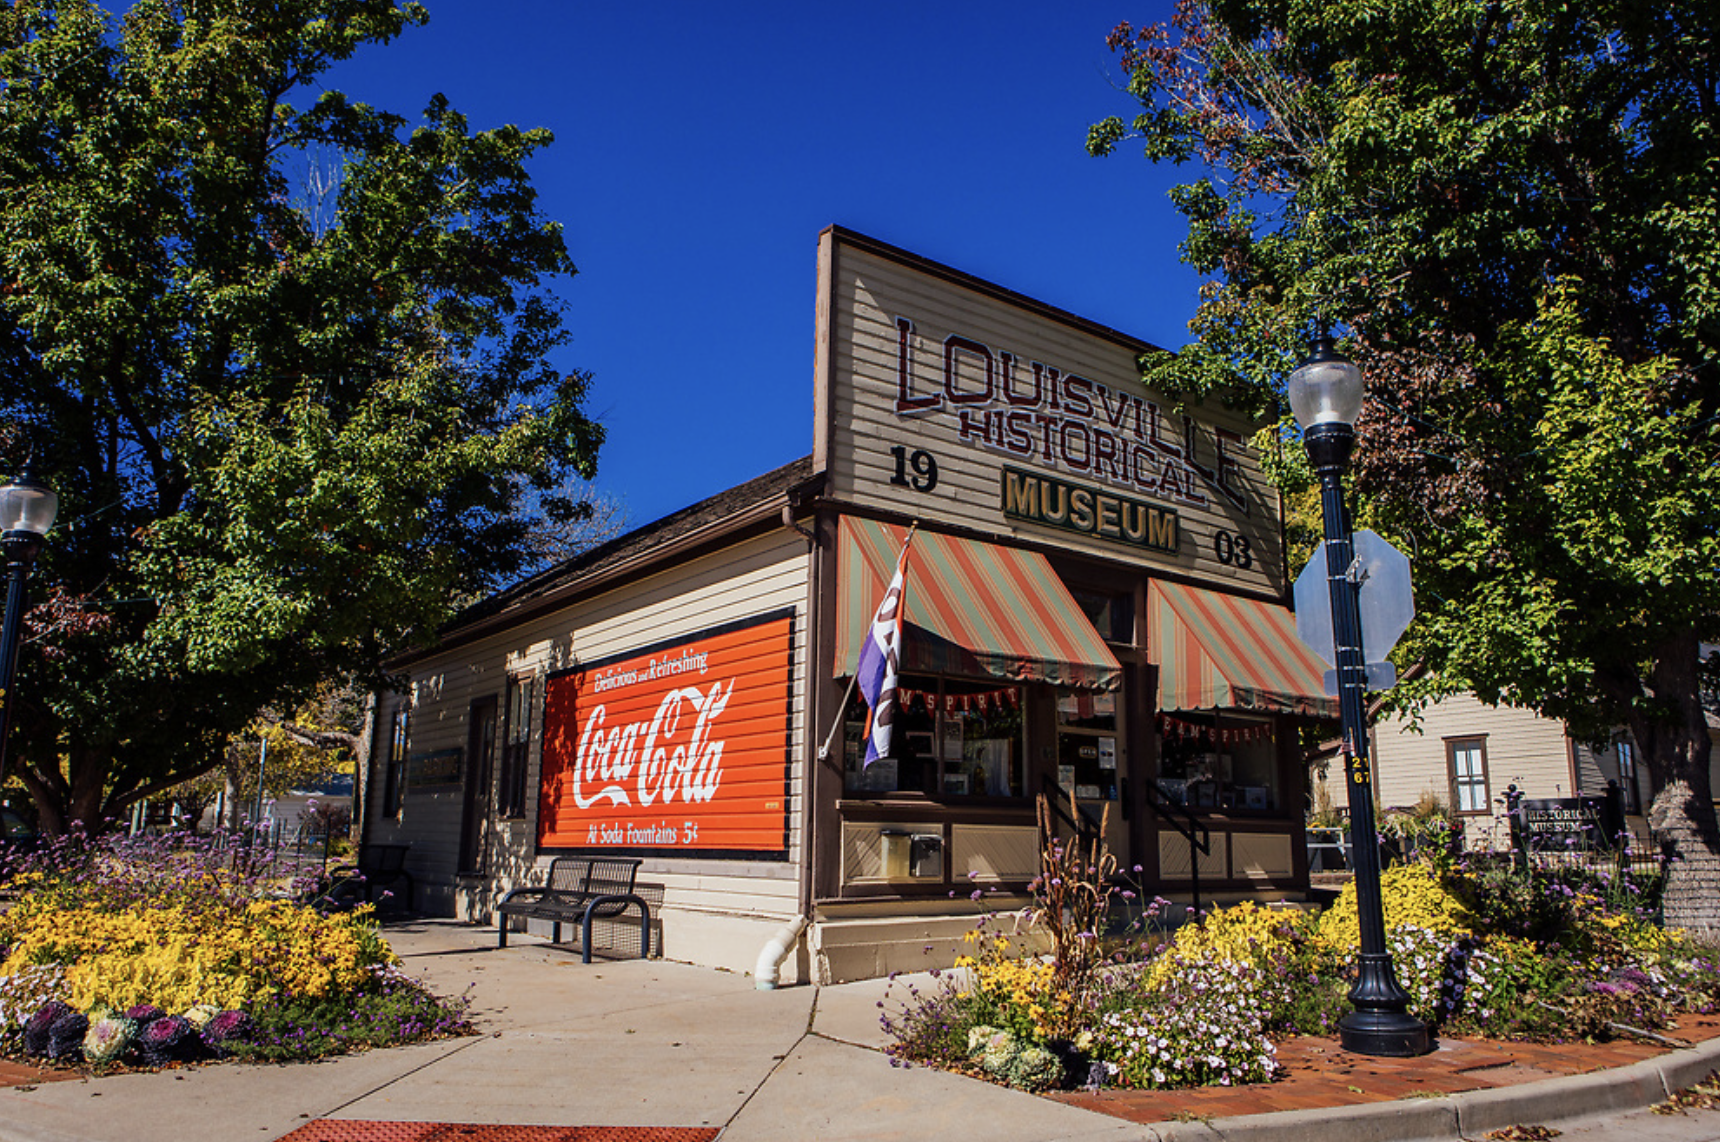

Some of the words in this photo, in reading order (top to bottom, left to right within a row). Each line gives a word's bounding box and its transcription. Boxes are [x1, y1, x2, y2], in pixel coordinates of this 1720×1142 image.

[895, 316, 1249, 515] LOUISVILLE
[889, 445, 938, 493] 19
[958, 409, 1209, 508] HISTORICAL
[1005, 470, 1177, 552] MUSEUM
[1214, 530, 1253, 569] 03
[594, 667, 638, 693] Delicious
[649, 648, 709, 679] Refreshing
[927, 688, 1017, 710] SPIRIT
[599, 822, 624, 844] Soda
[627, 820, 677, 844] Fountains
[1529, 821, 1582, 832] MUSEUM
